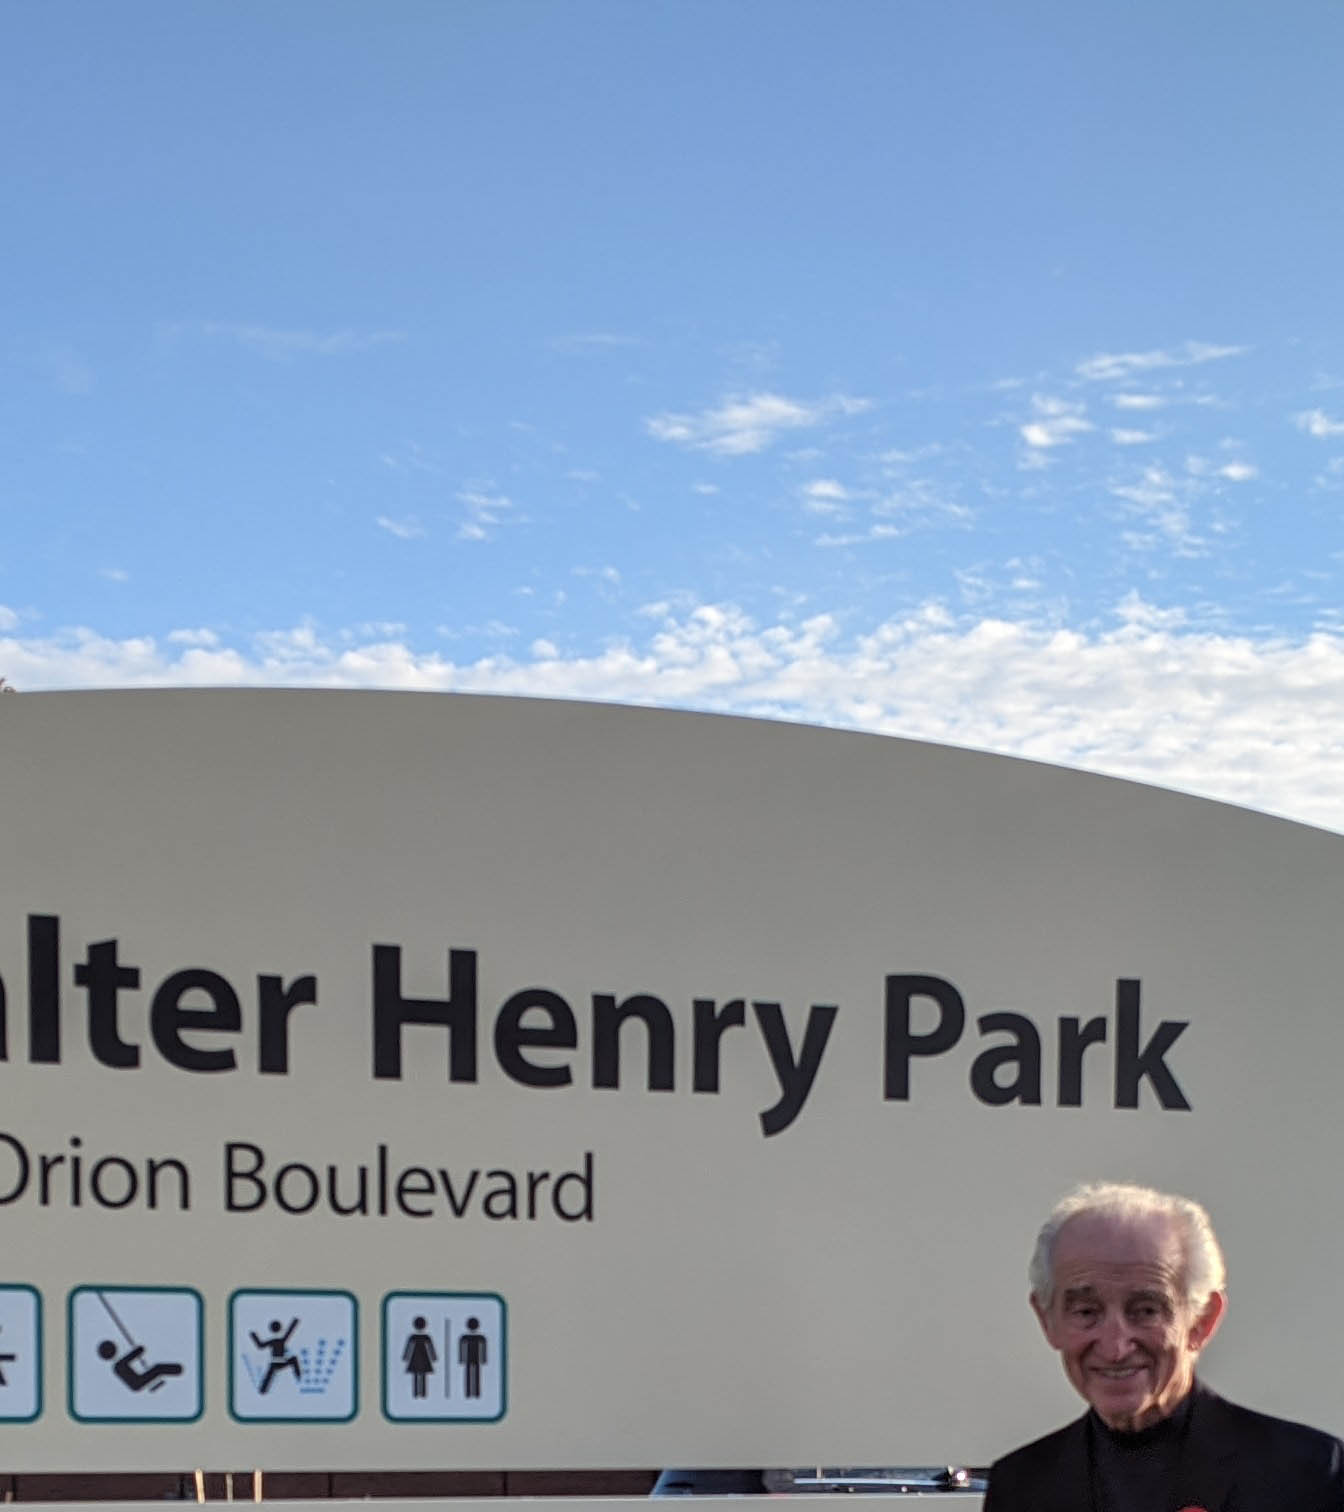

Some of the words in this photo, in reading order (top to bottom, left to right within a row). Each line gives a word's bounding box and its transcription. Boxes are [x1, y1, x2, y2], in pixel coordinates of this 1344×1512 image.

[371, 943, 840, 1138] Henry
[883, 973, 1193, 1112] Park
[223, 1141, 595, 1223] Boulevard
